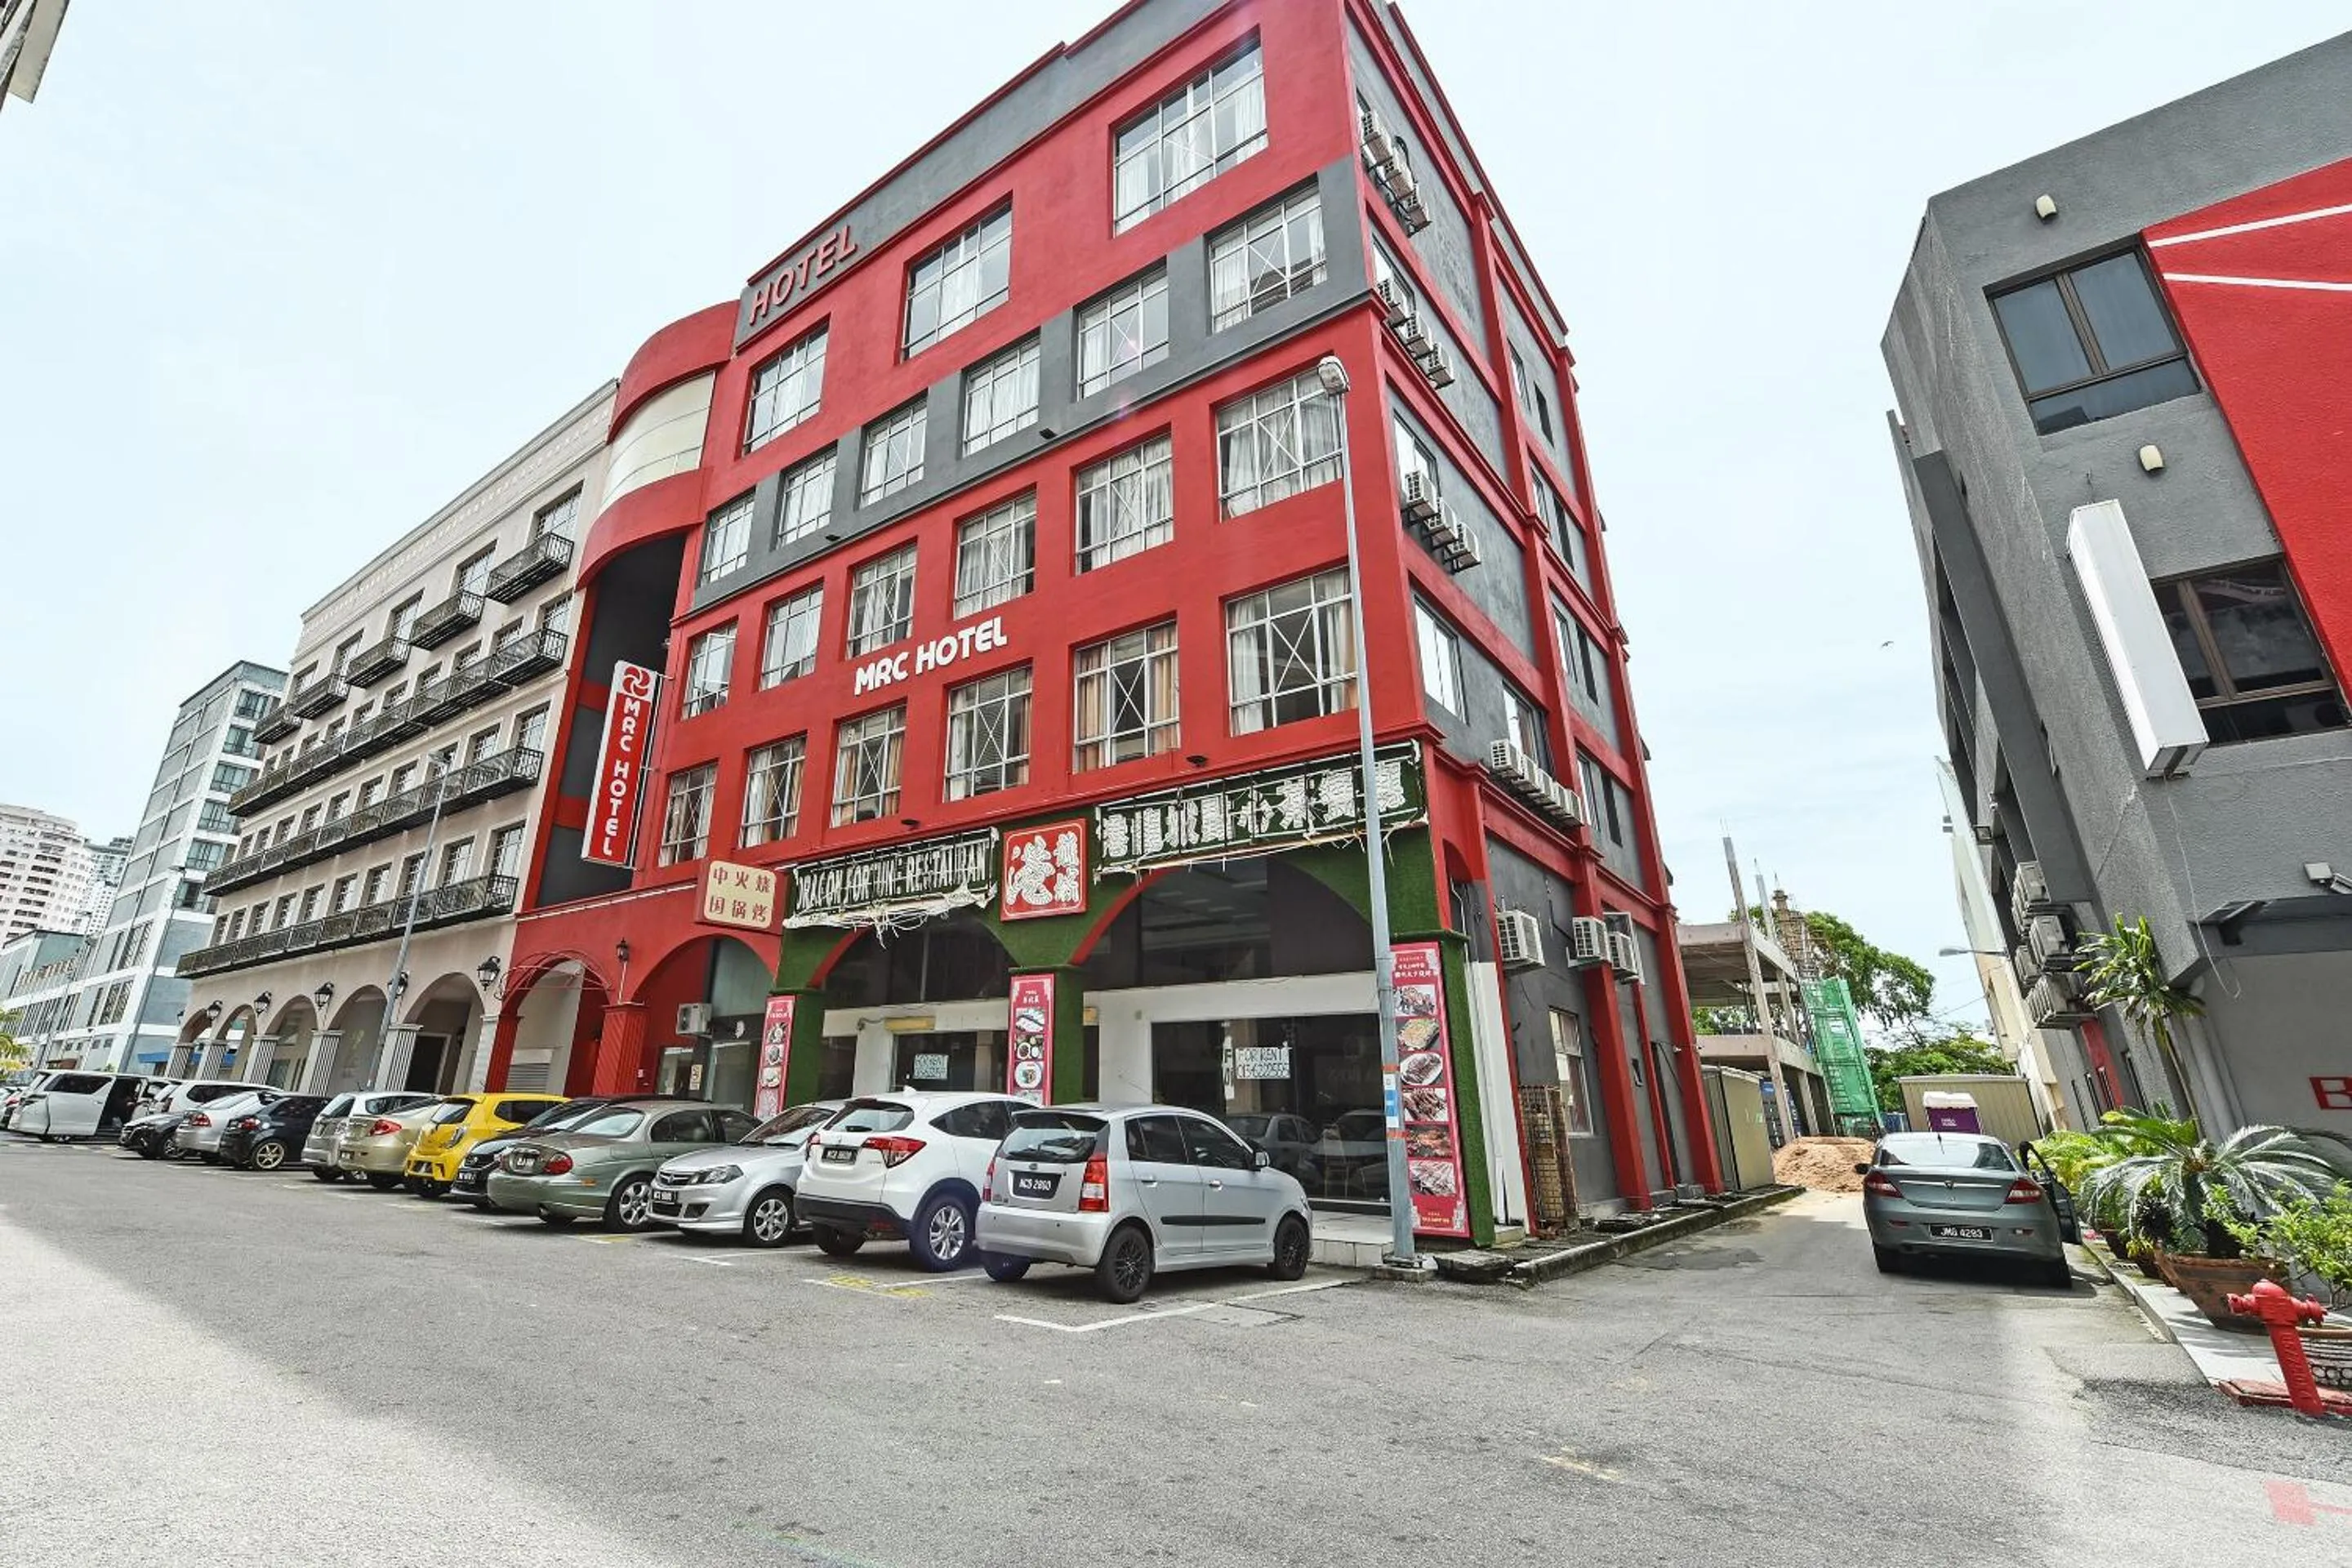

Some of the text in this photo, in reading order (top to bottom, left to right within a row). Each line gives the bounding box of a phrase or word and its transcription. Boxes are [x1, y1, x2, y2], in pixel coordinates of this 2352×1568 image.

[750, 225, 858, 327] HOTEL
[854, 616, 1008, 696] MRC HOTEL
[603, 697, 641, 857] MRC HOTEL
